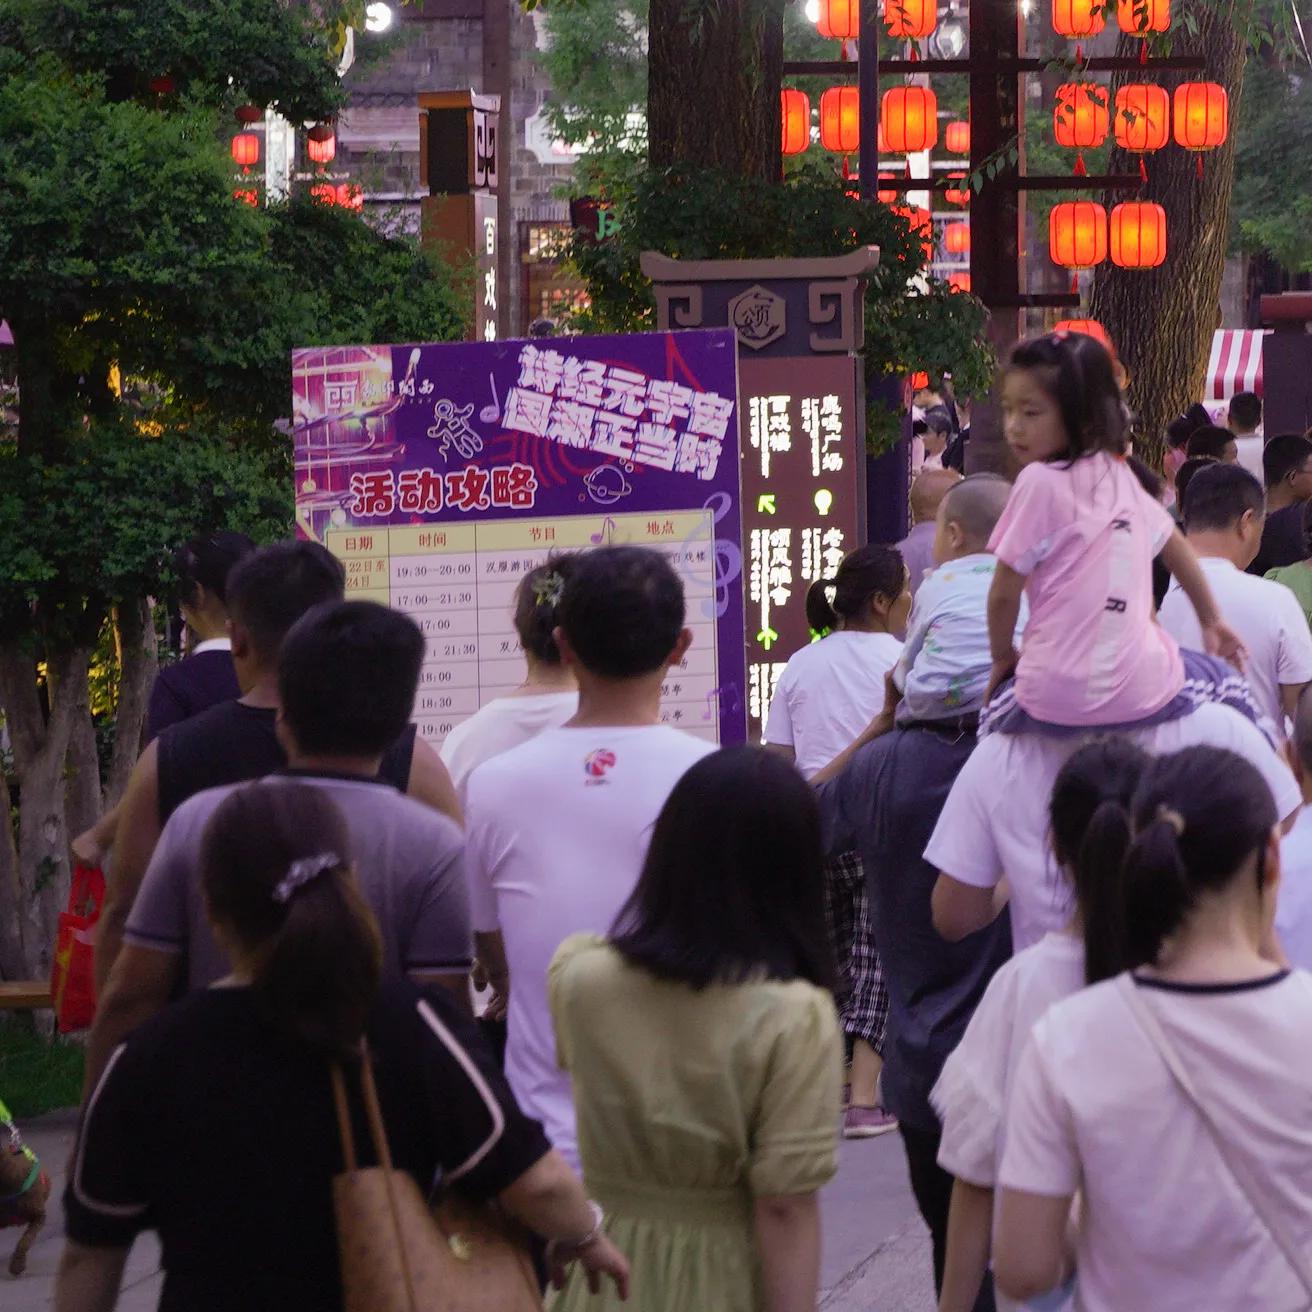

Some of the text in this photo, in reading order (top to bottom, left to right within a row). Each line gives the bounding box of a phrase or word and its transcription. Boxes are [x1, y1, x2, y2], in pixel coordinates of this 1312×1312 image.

[517, 344, 735, 440] 诗经元宇宙
[501, 387, 723, 481] 国潮正当时
[351, 462, 538, 517] 活动攻略
[529, 527, 555, 542] 节目
[647, 520, 674, 536] 地点
[345, 536, 373, 551] 日期
[418, 532, 447, 548] 时间
